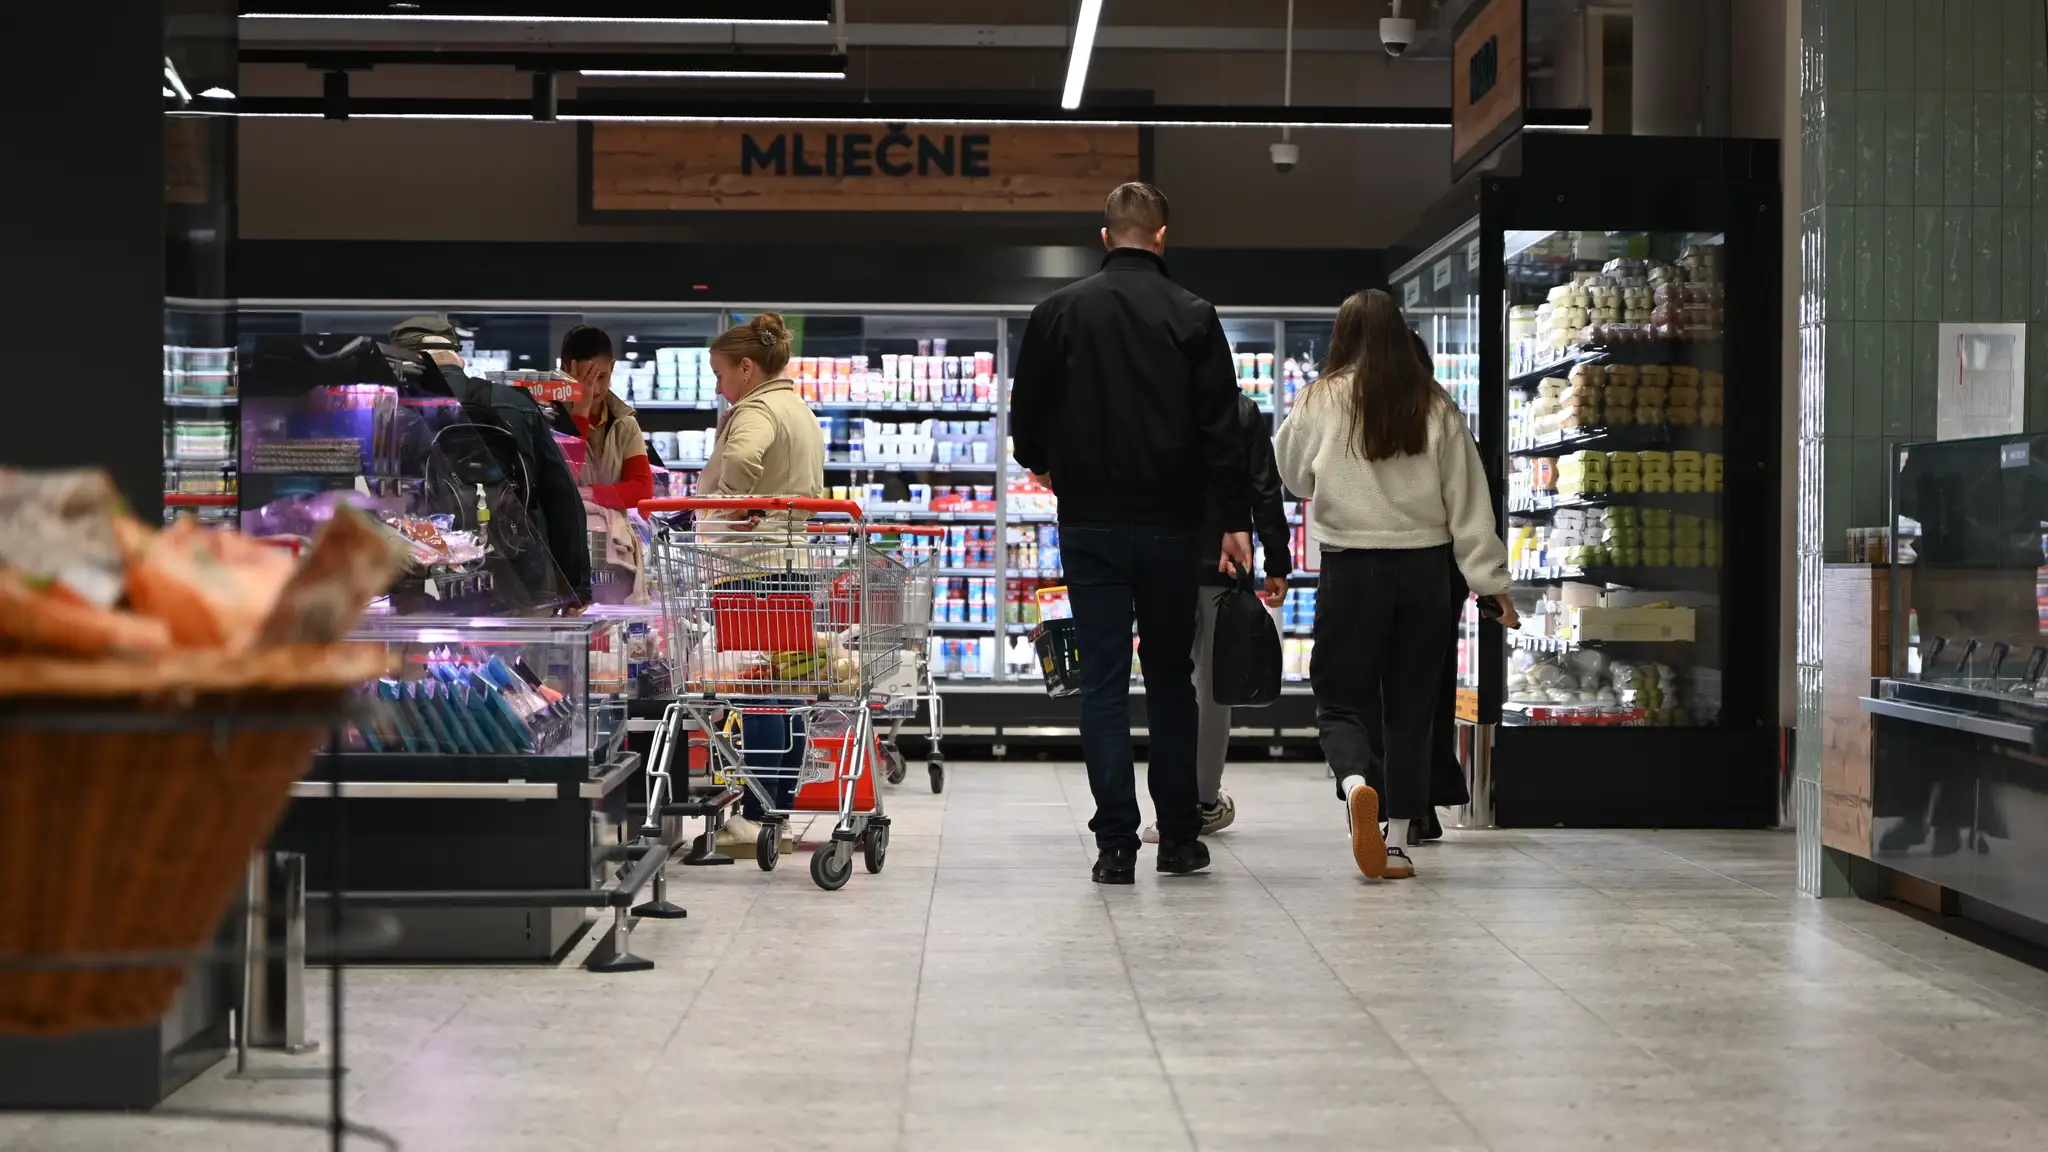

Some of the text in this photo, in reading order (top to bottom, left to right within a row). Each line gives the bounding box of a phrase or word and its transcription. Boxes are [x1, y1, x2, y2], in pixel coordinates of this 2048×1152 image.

[741, 122, 990, 177] MLIEČNE
[527, 382, 544, 397] ajo
[552, 383, 573, 401] rajo
